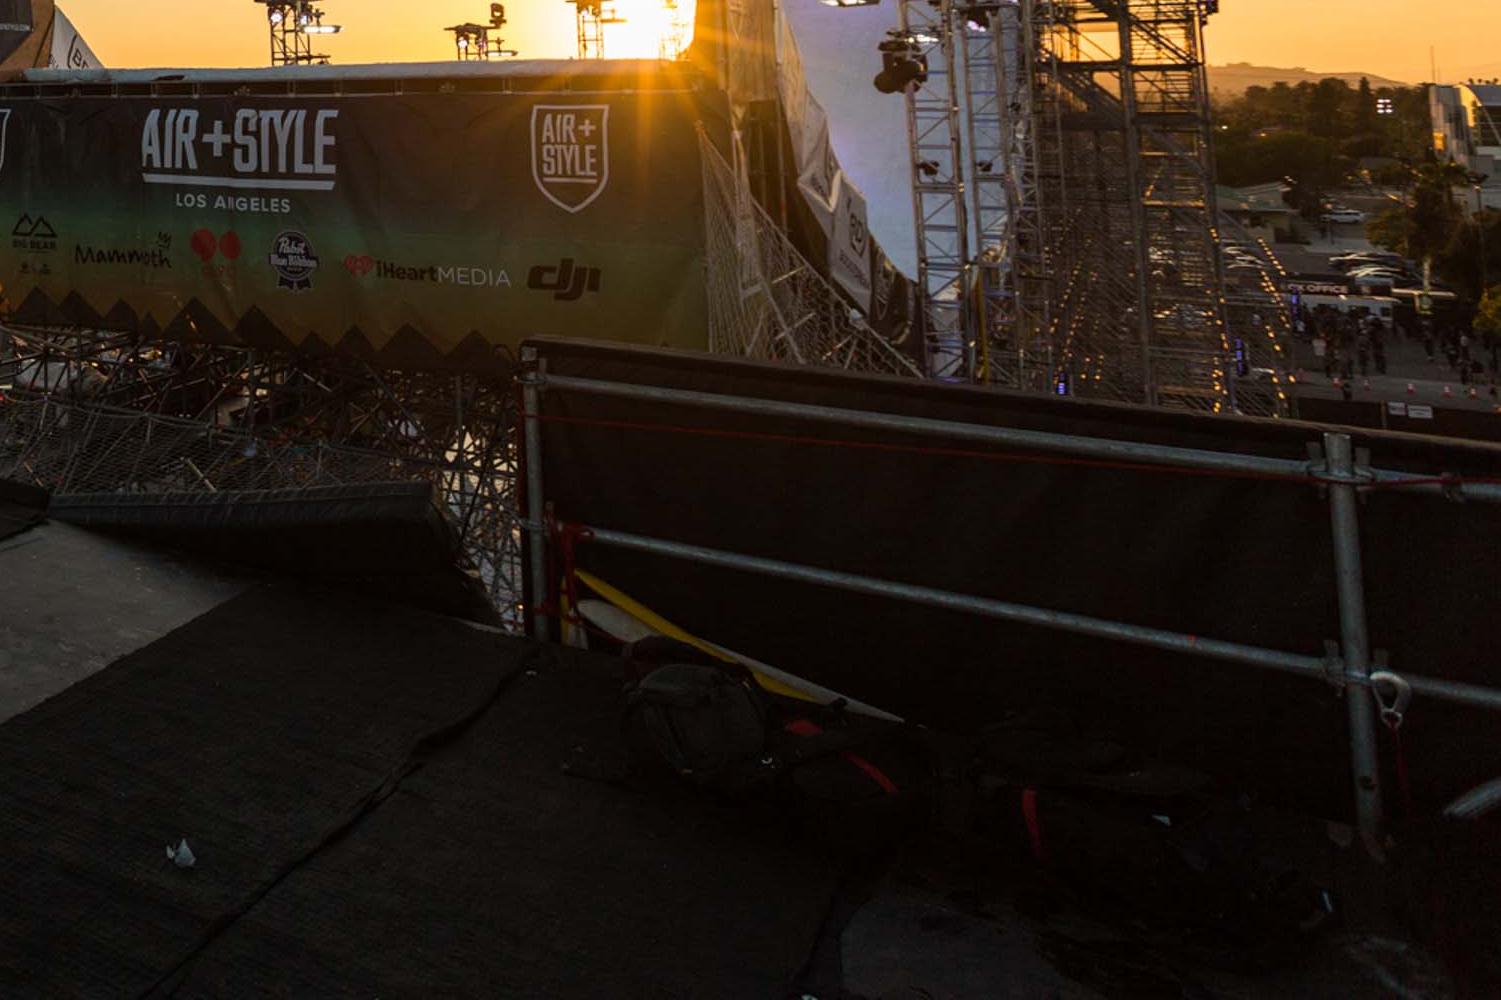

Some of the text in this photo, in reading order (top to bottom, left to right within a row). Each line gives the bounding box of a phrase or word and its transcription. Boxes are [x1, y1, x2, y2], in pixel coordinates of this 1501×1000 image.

[141, 108, 340, 175] AIR+STYLE
[542, 113, 597, 143] AIR+
[542, 144, 597, 176] STYLE
[175, 193, 207, 208] LOS
[74, 243, 173, 269] Mammoth
[1306, 284, 1349, 295] OFFICE
